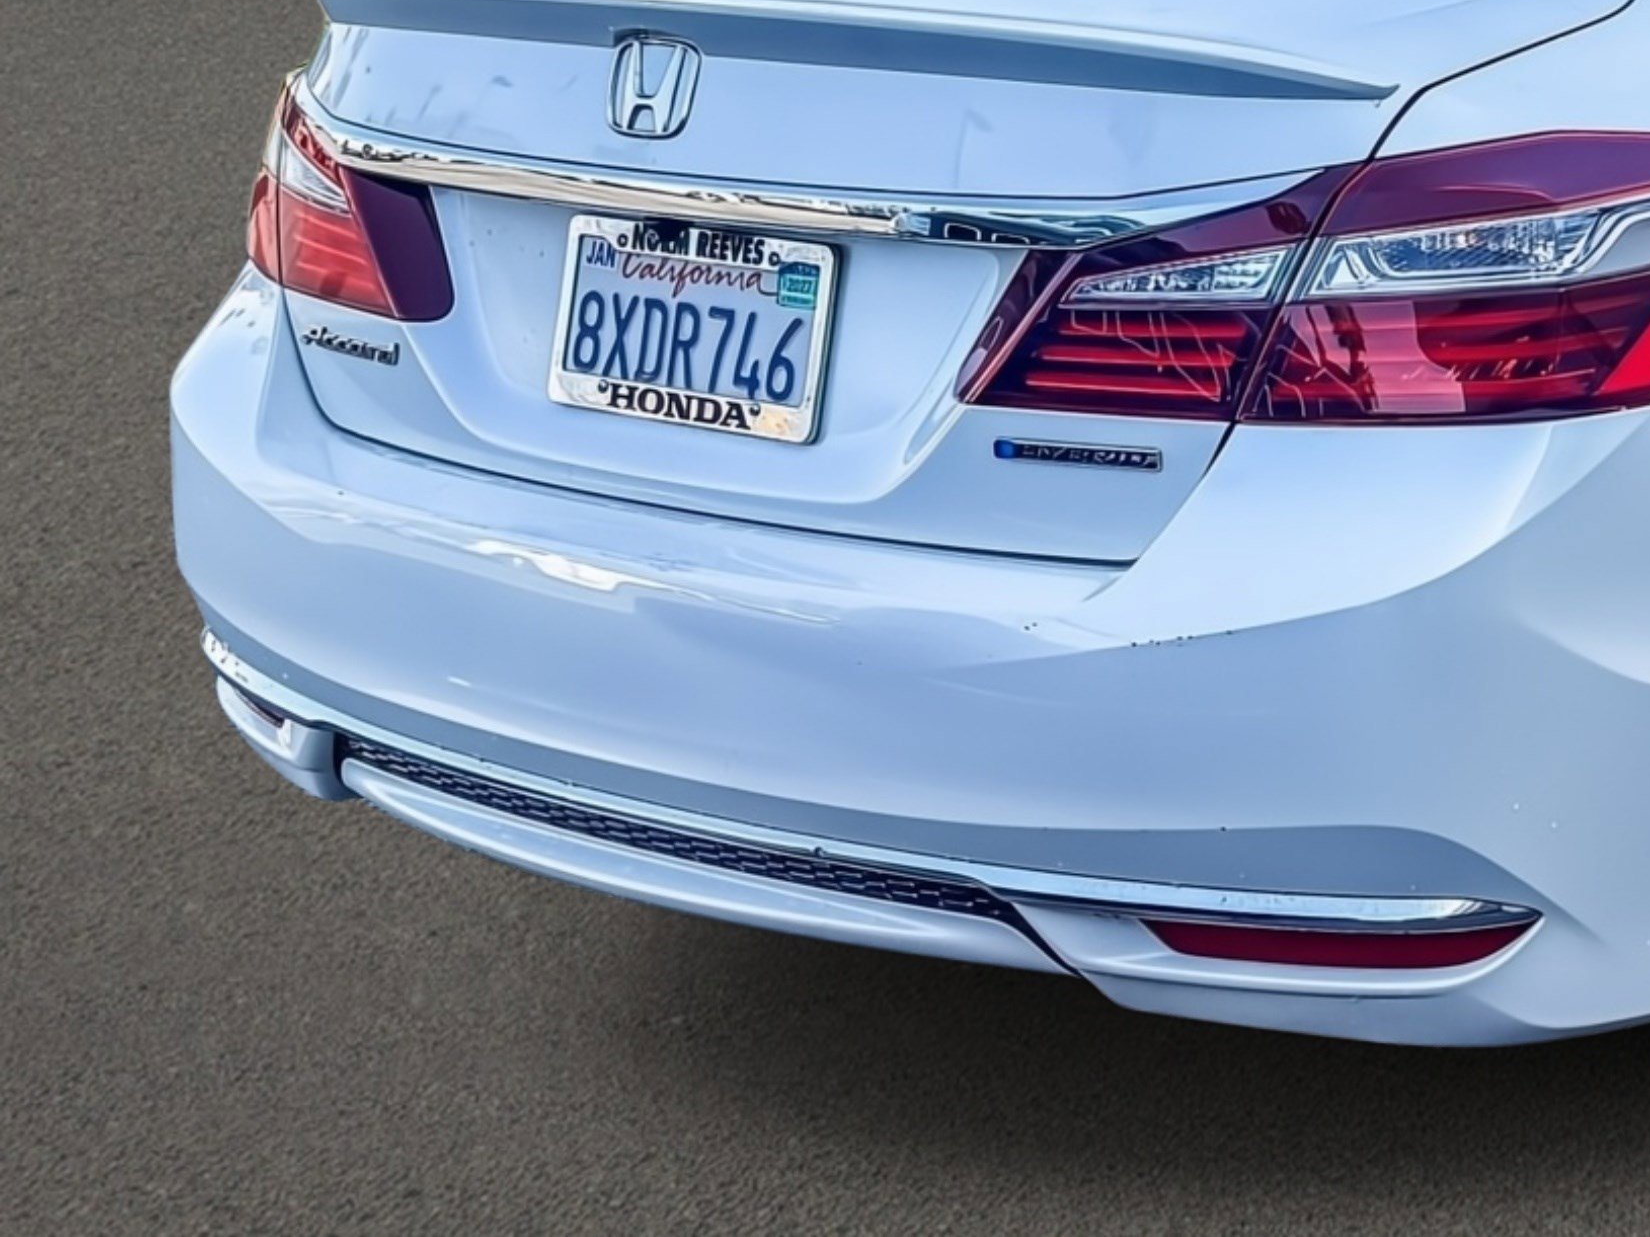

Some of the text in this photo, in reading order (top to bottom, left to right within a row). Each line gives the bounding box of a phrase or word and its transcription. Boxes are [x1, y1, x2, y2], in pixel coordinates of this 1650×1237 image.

[586, 241, 616, 268] JAN
[695, 230, 767, 266] REEVES
[621, 255, 779, 298] California
[573, 290, 803, 402] 8XDR746
[605, 381, 752, 430] HONDA
